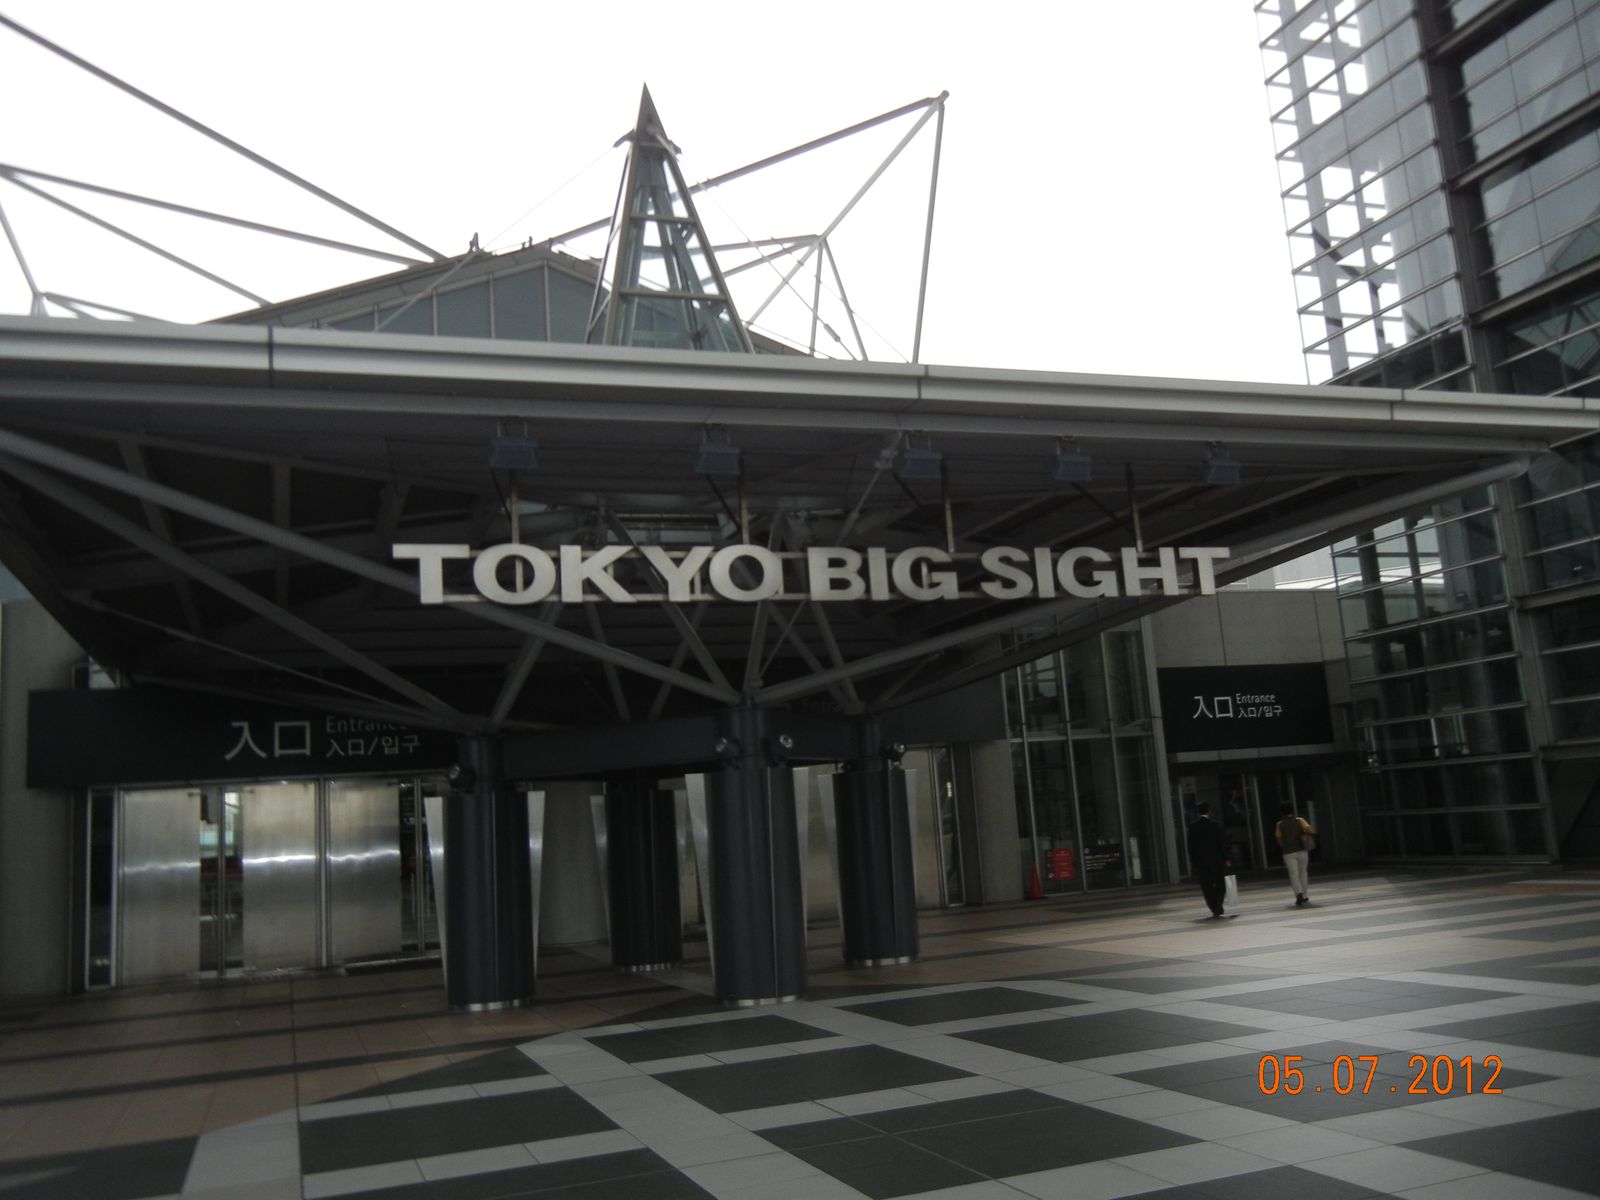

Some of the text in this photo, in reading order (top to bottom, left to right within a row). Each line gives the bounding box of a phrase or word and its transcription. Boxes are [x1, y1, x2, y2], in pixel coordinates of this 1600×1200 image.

[392, 543, 1231, 605] TOKYO BIG SIGHT
[1193, 695, 1234, 719] 入口
[1235, 693, 1276, 704] Entrance
[224, 720, 312, 761] 入口
